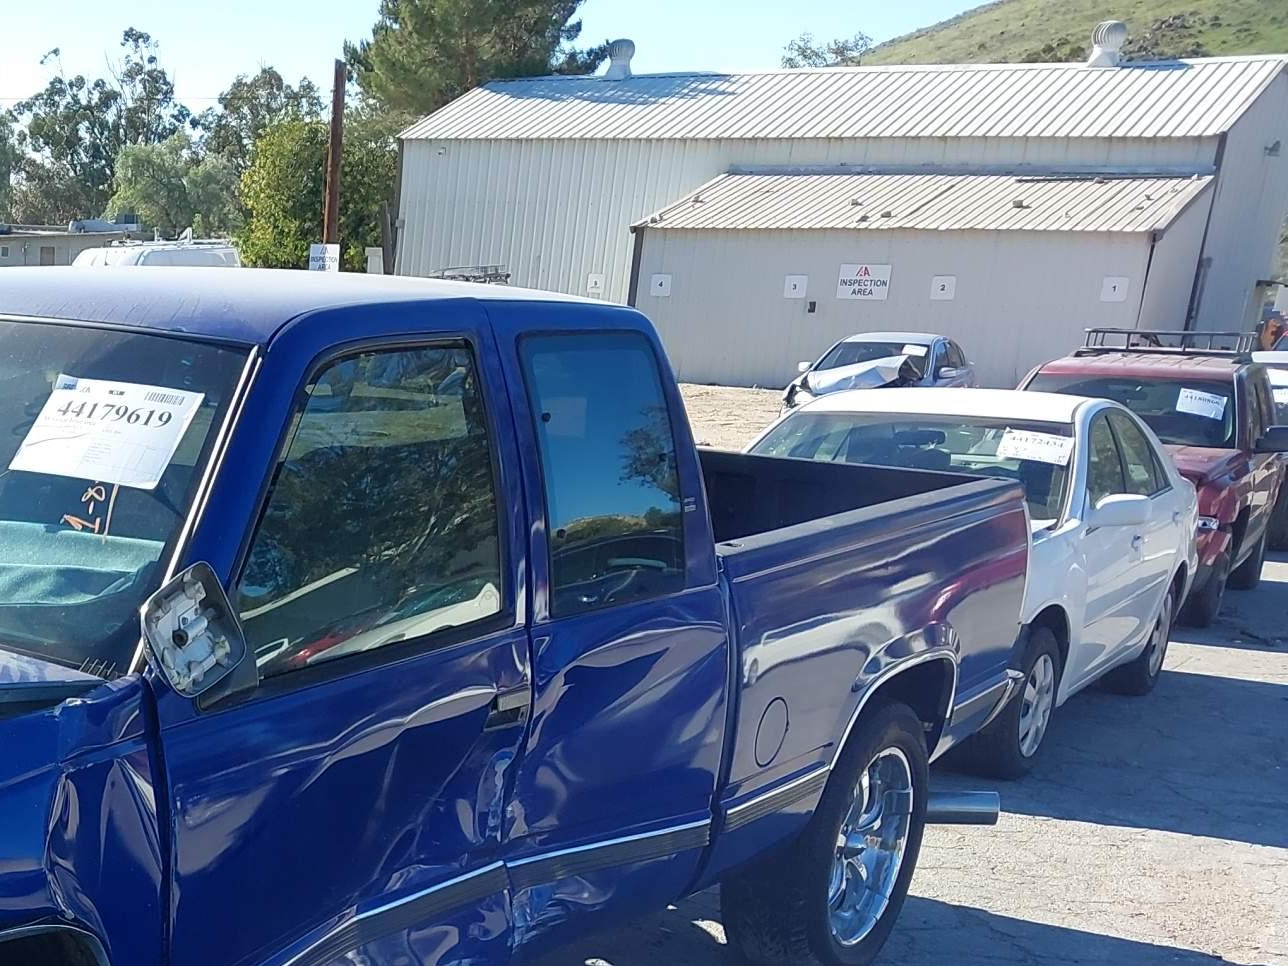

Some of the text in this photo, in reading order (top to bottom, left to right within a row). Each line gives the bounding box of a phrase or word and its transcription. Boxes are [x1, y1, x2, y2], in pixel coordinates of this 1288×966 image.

[839, 279, 888, 287] INSPECTION
[850, 288, 873, 296] AREA
[57, 399, 173, 429] 44179619
